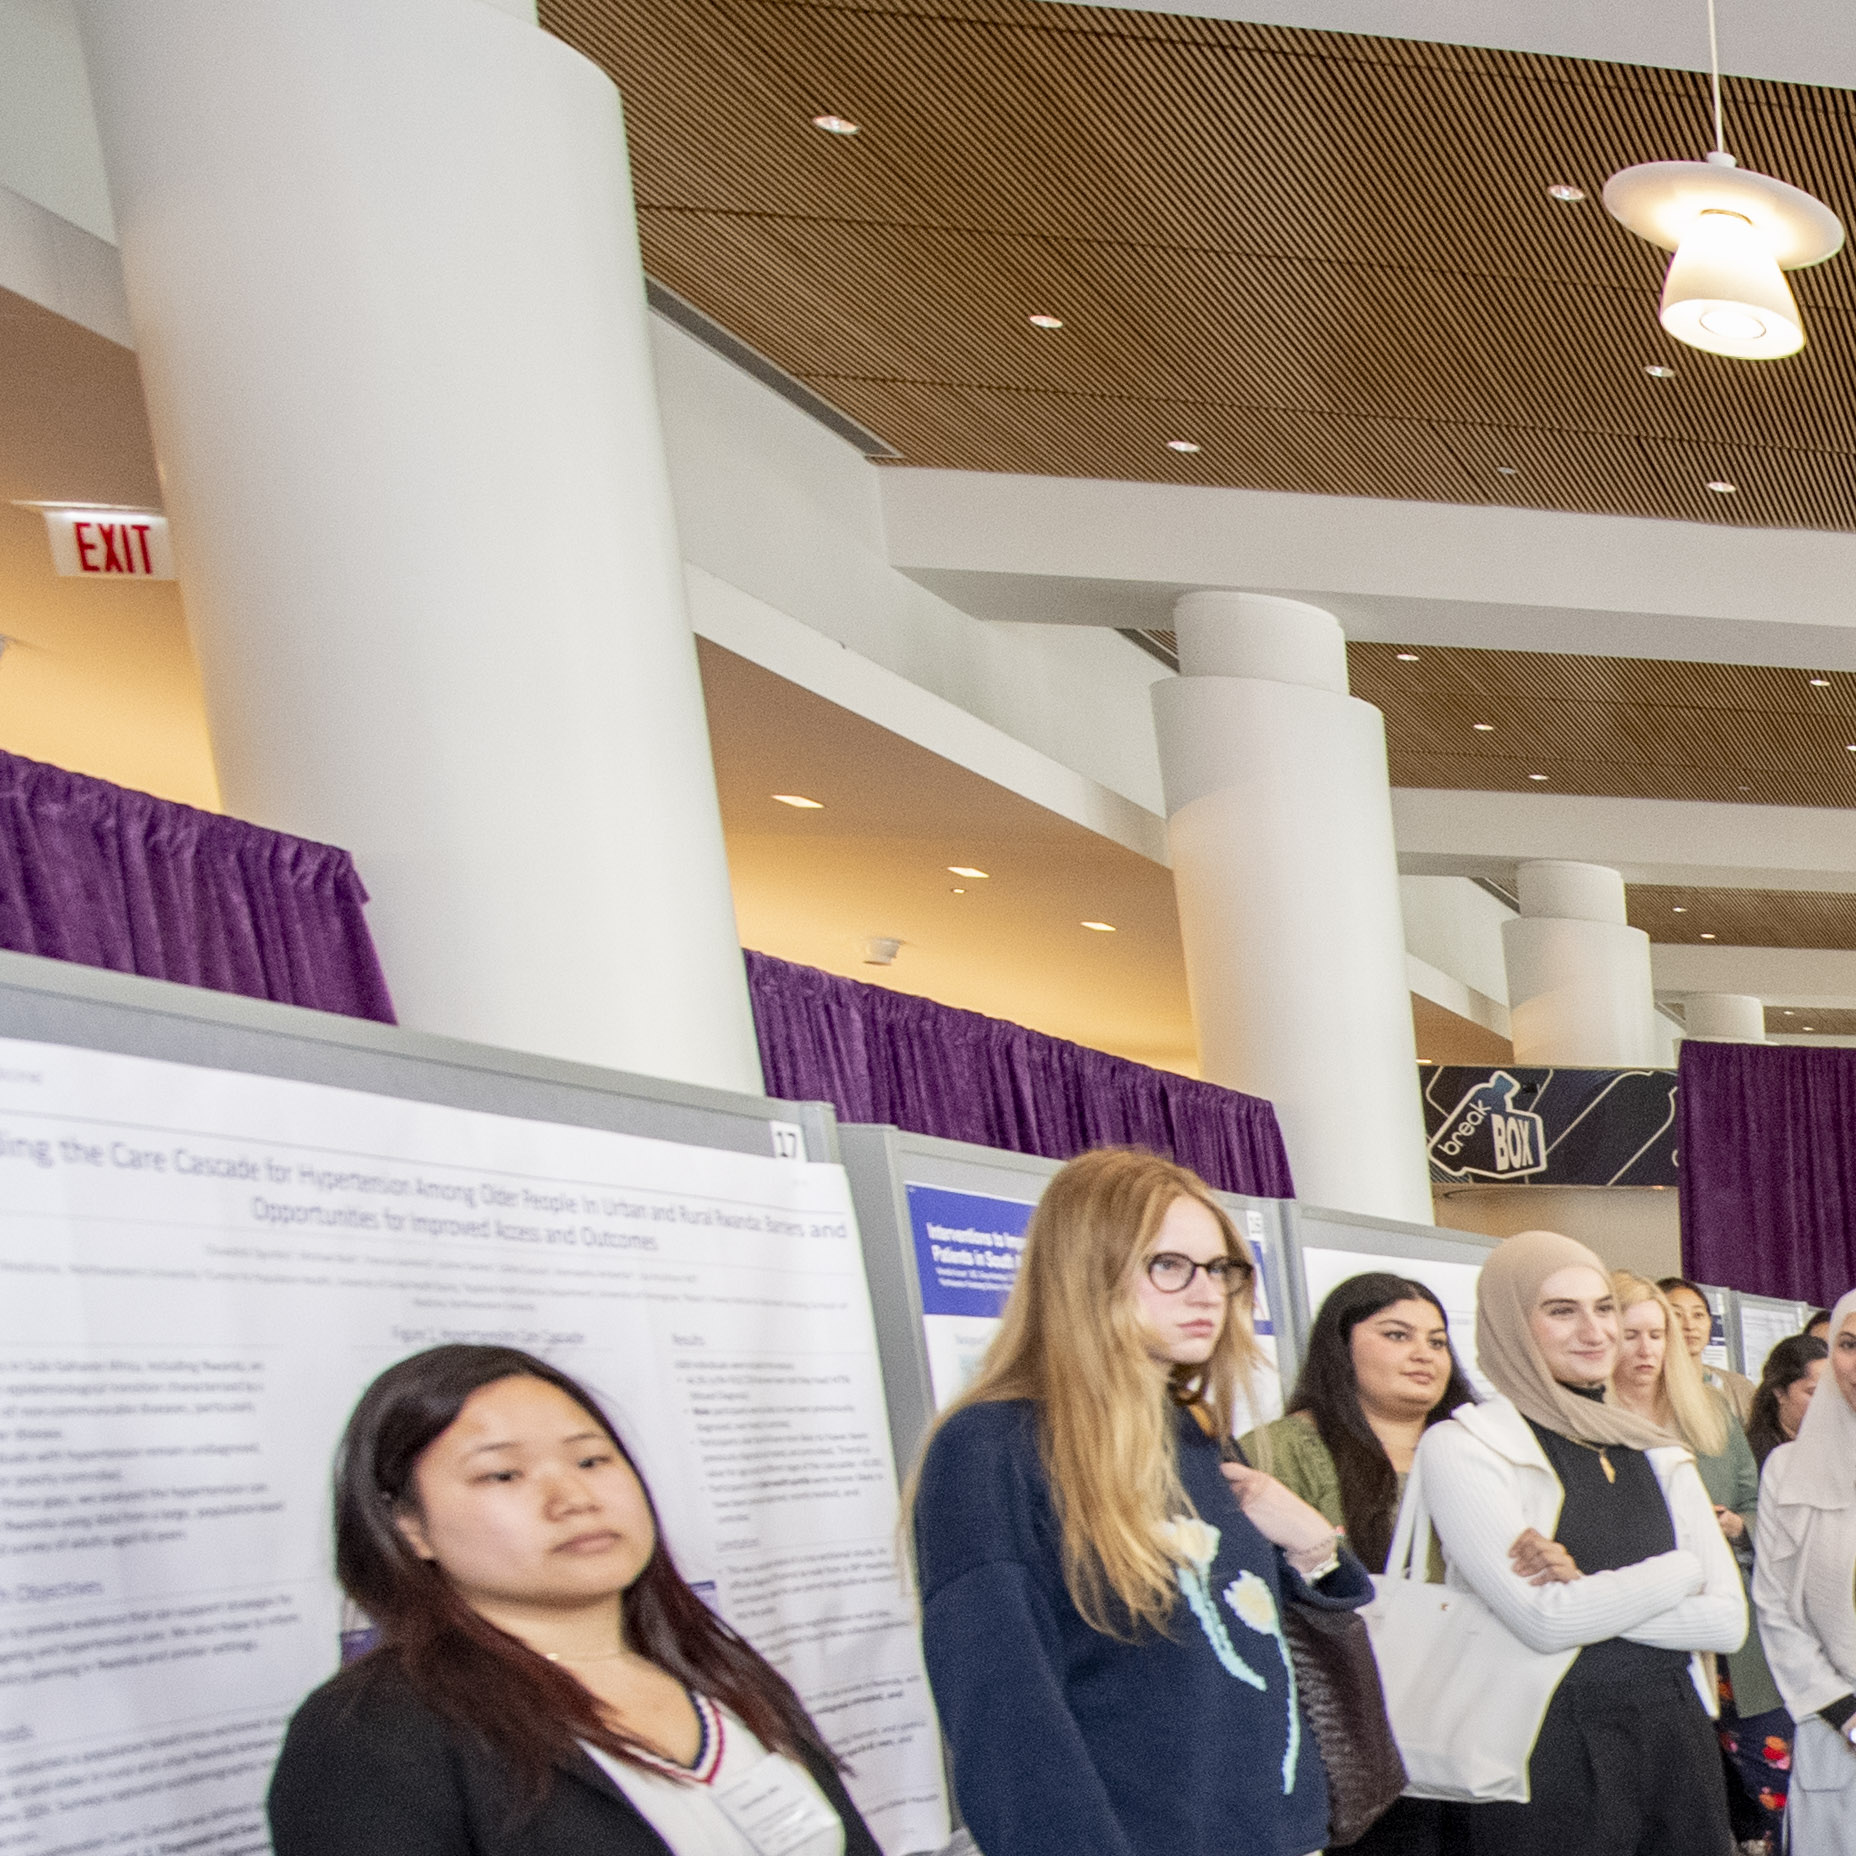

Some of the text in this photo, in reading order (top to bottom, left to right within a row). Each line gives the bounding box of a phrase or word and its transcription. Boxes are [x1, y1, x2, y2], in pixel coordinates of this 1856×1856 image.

[74, 522, 153, 574] EXIT
[777, 1131, 797, 1158] 17
[1437, 1099, 1492, 1157] break
[1490, 1113, 1534, 1171] BOX
[59, 1139, 105, 1168] the
[111, 1141, 167, 1174] Care
[174, 1147, 262, 1183] Cascade
[266, 1157, 294, 1185] for
[299, 1161, 411, 1198] Hypertension
[415, 1177, 478, 1209] Among
[481, 1182, 520, 1209] Older
[522, 1187, 578, 1218] People
[603, 1198, 646, 1222] Urban
[651, 1203, 677, 1223] and
[810, 1220, 848, 1240] and
[252, 1195, 380, 1231] Opportunities
[383, 1206, 409, 1232] for
[544, 1225, 577, 1247] and
[580, 1226, 660, 1253] Outcomes
[926, 1222, 993, 1247] Interventions
[931, 1244, 974, 1266] Patients
